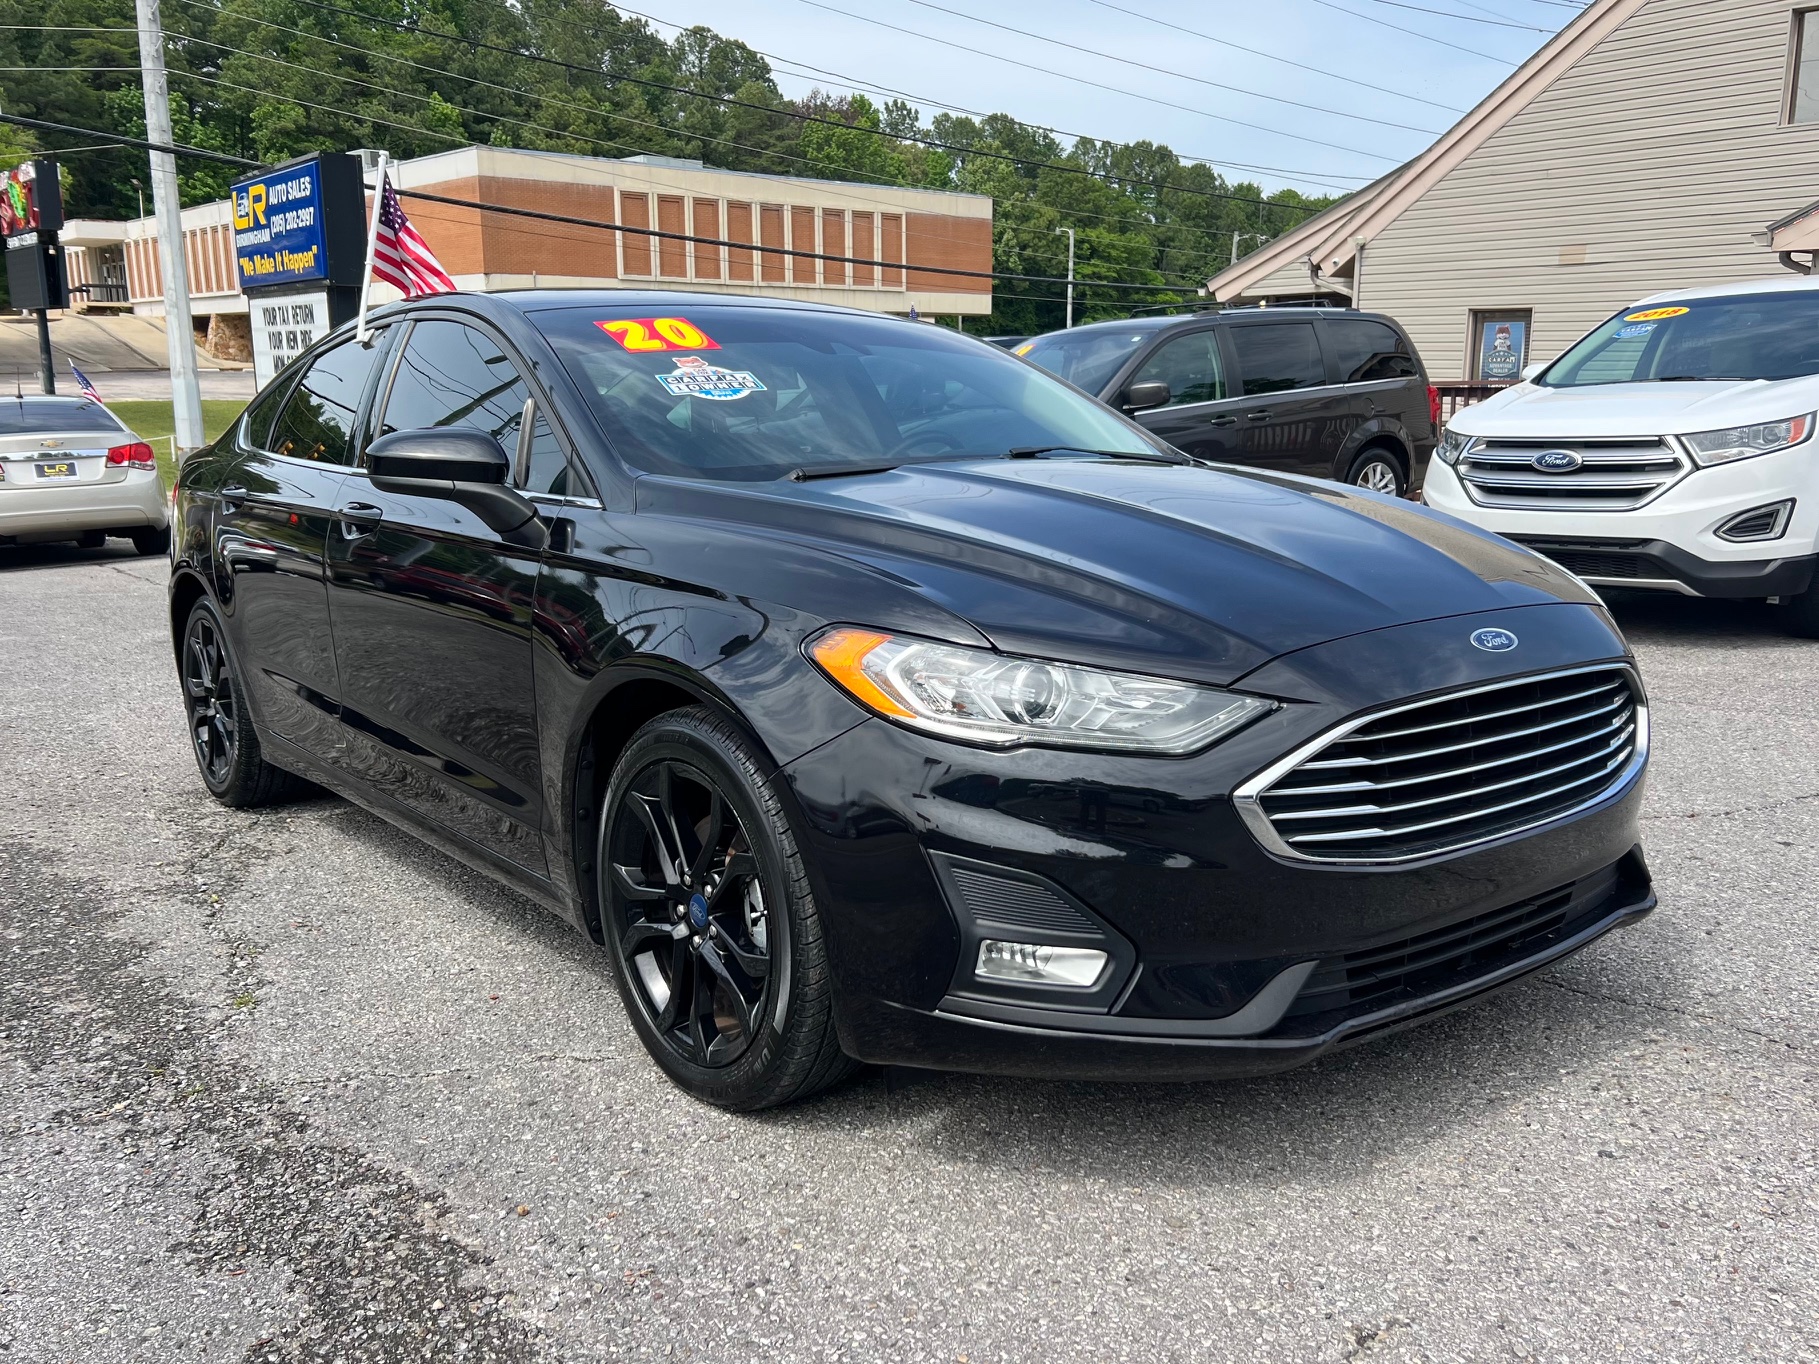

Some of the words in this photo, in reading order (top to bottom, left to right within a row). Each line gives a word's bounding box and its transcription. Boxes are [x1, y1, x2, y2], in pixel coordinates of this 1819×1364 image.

[269, 183, 287, 205] AUTO
[287, 176, 312, 200] SALES
[232, 184, 267, 230] LR
[270, 212, 286, 238] (205)
[285, 206, 315, 230] 202-2997
[236, 228, 270, 248] BIRMINGHAM
[240, 257, 254, 277] "We
[254, 253, 275, 275] Make
[275, 251, 283, 272] It
[283, 245, 318, 275] Happen"
[262, 306, 278, 327] YOUR
[278, 305, 290, 325] TAX
[291, 303, 315, 325] RETURN
[268, 331, 283, 350] YOUR
[602, 318, 708, 350] 20
[665, 374, 753, 384] CARFAX
[687, 381, 758, 391] OWNER
[1541, 454, 1570, 466] Ford
[1481, 632, 1509, 647] Ford
